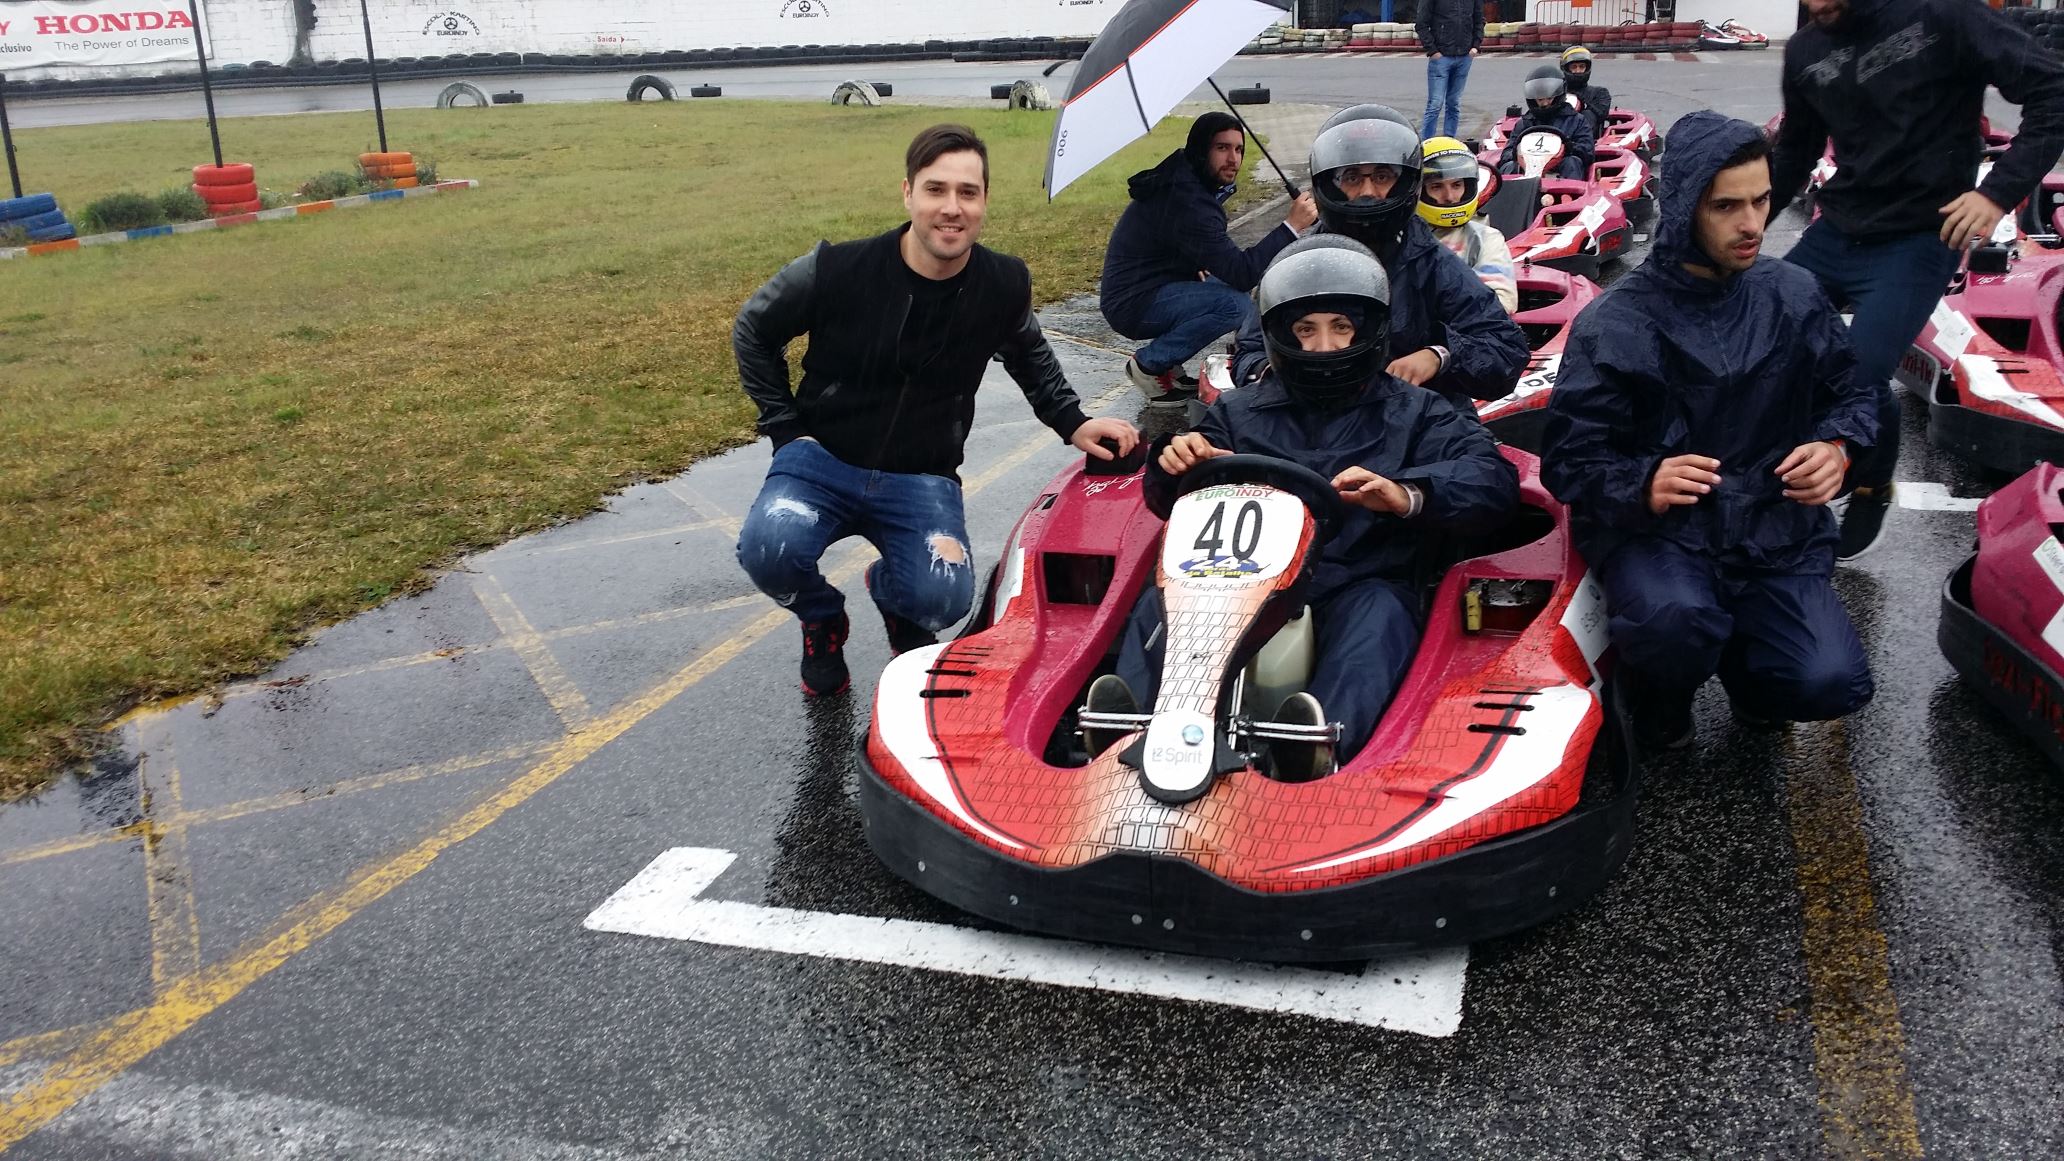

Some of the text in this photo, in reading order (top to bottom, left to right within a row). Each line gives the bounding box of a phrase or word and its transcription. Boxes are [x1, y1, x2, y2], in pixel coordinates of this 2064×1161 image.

[34, 11, 192, 35] HONDA
[55, 36, 190, 51] The Power of Dreams
[1534, 135, 1544, 151] 4
[1196, 488, 1274, 501] EUROINDY
[1193, 500, 1262, 560] 40
[1165, 747, 1203, 766] Spirit
